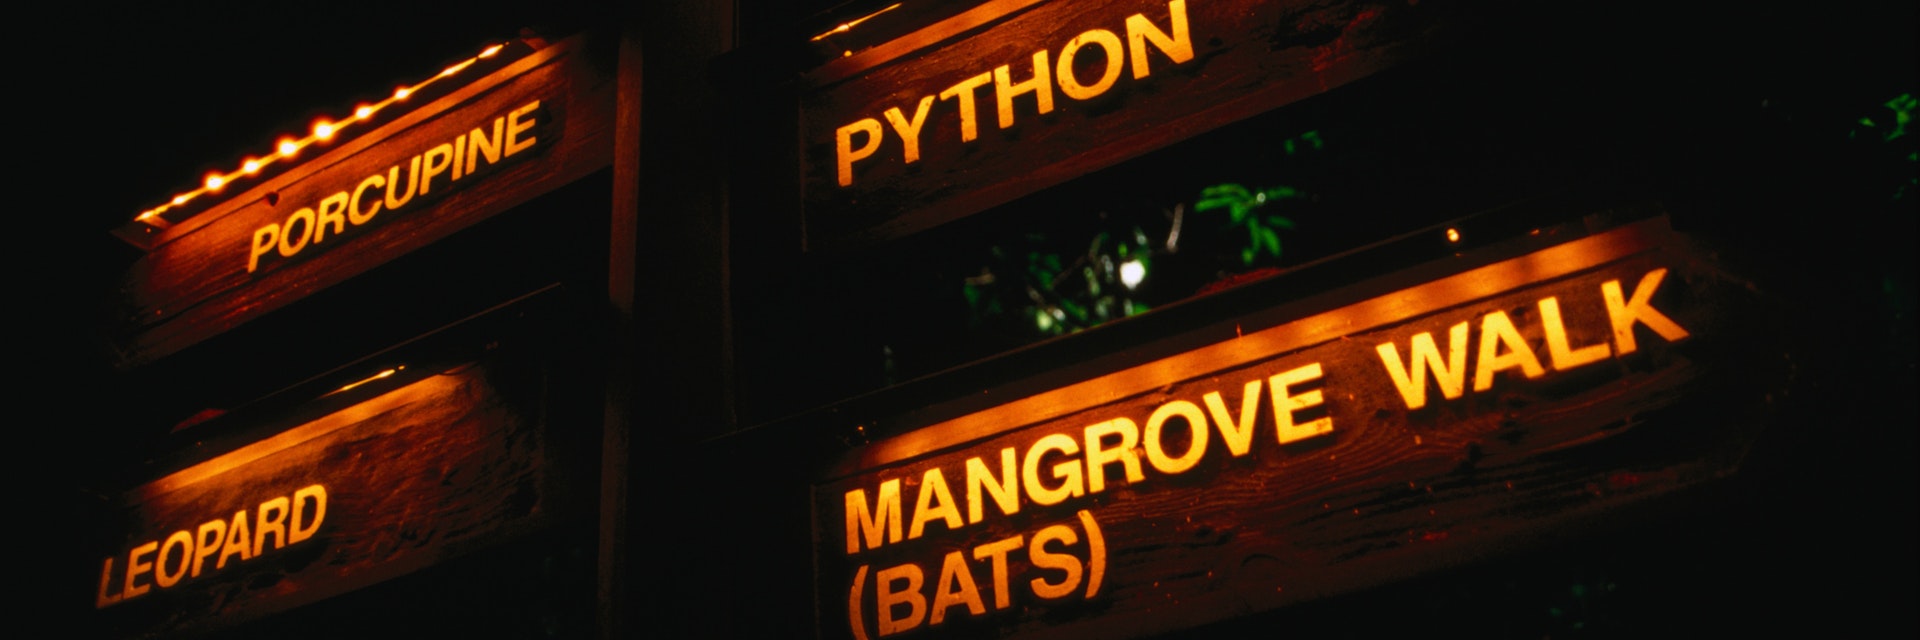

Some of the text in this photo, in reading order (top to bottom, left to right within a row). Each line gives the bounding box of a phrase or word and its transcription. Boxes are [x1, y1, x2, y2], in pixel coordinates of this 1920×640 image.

[836, 0, 1194, 187] PYTHON
[247, 100, 541, 273] PORCUPINE
[845, 268, 1690, 554] MANGROVE WALK
[96, 484, 328, 608] LEOPARD
[848, 510, 1106, 639] (BATS)
